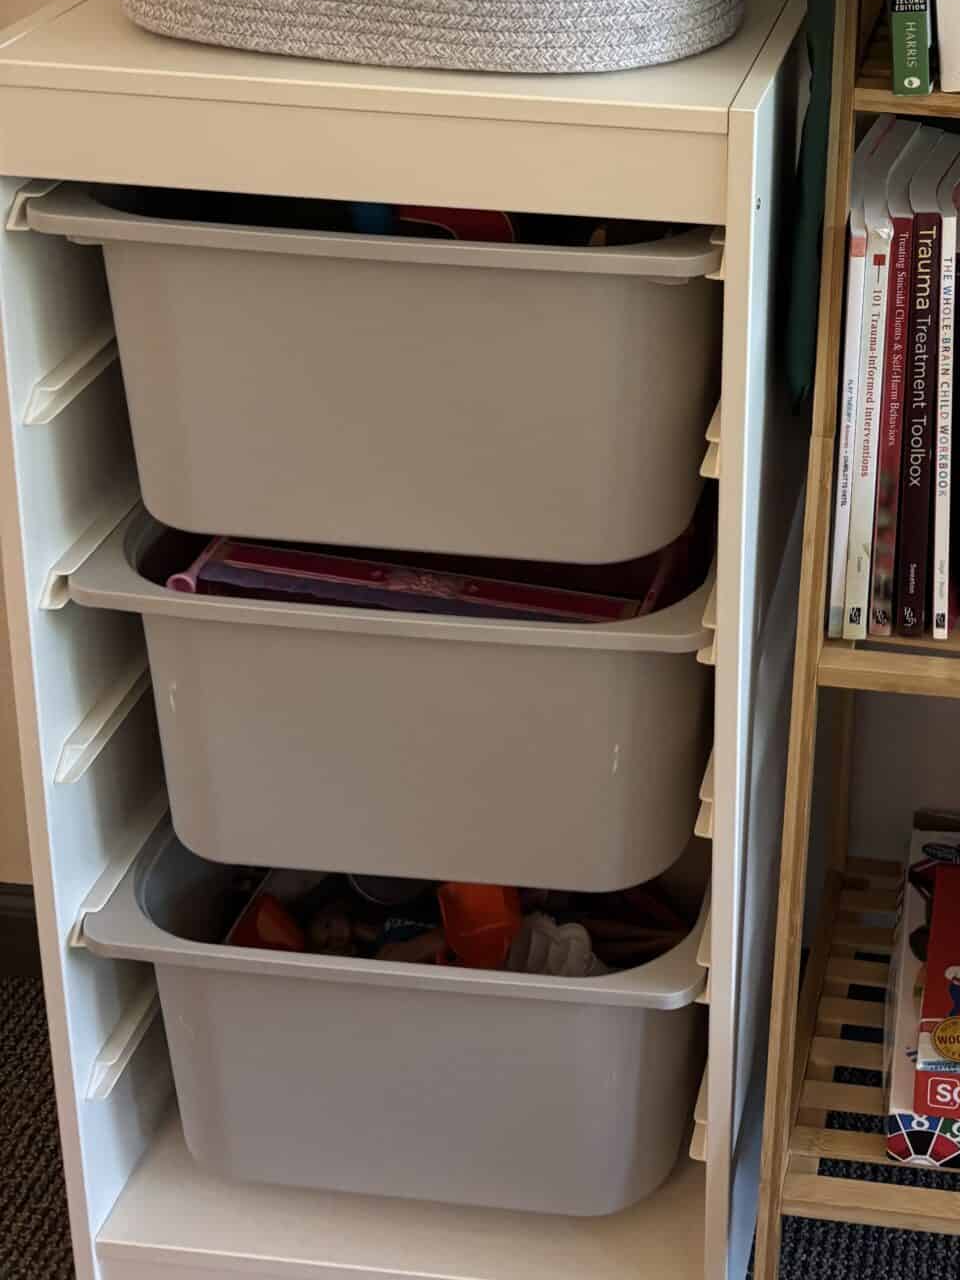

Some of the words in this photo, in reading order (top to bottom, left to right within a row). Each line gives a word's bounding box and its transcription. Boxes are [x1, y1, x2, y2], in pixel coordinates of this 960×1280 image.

[896, 231, 909, 268] Treating
[916, 226, 937, 310] Trauma
[943, 256, 953, 281] THE
[872, 288, 882, 308] 101
[895, 271, 908, 307] Suicidal
[893, 309, 905, 340] Clients
[941, 286, 952, 376] WHOLE-BRAIN
[864, 312, 881, 404] Trauma-Informed
[890, 353, 903, 400] Self-Harm
[912, 314, 932, 408] Treatment
[940, 381, 951, 419] CHILD
[860, 407, 874, 477] Interventions
[888, 402, 900, 447] Behaviors
[908, 415, 928, 487] Toolbox
[938, 424, 950, 497] WORKBOOK
